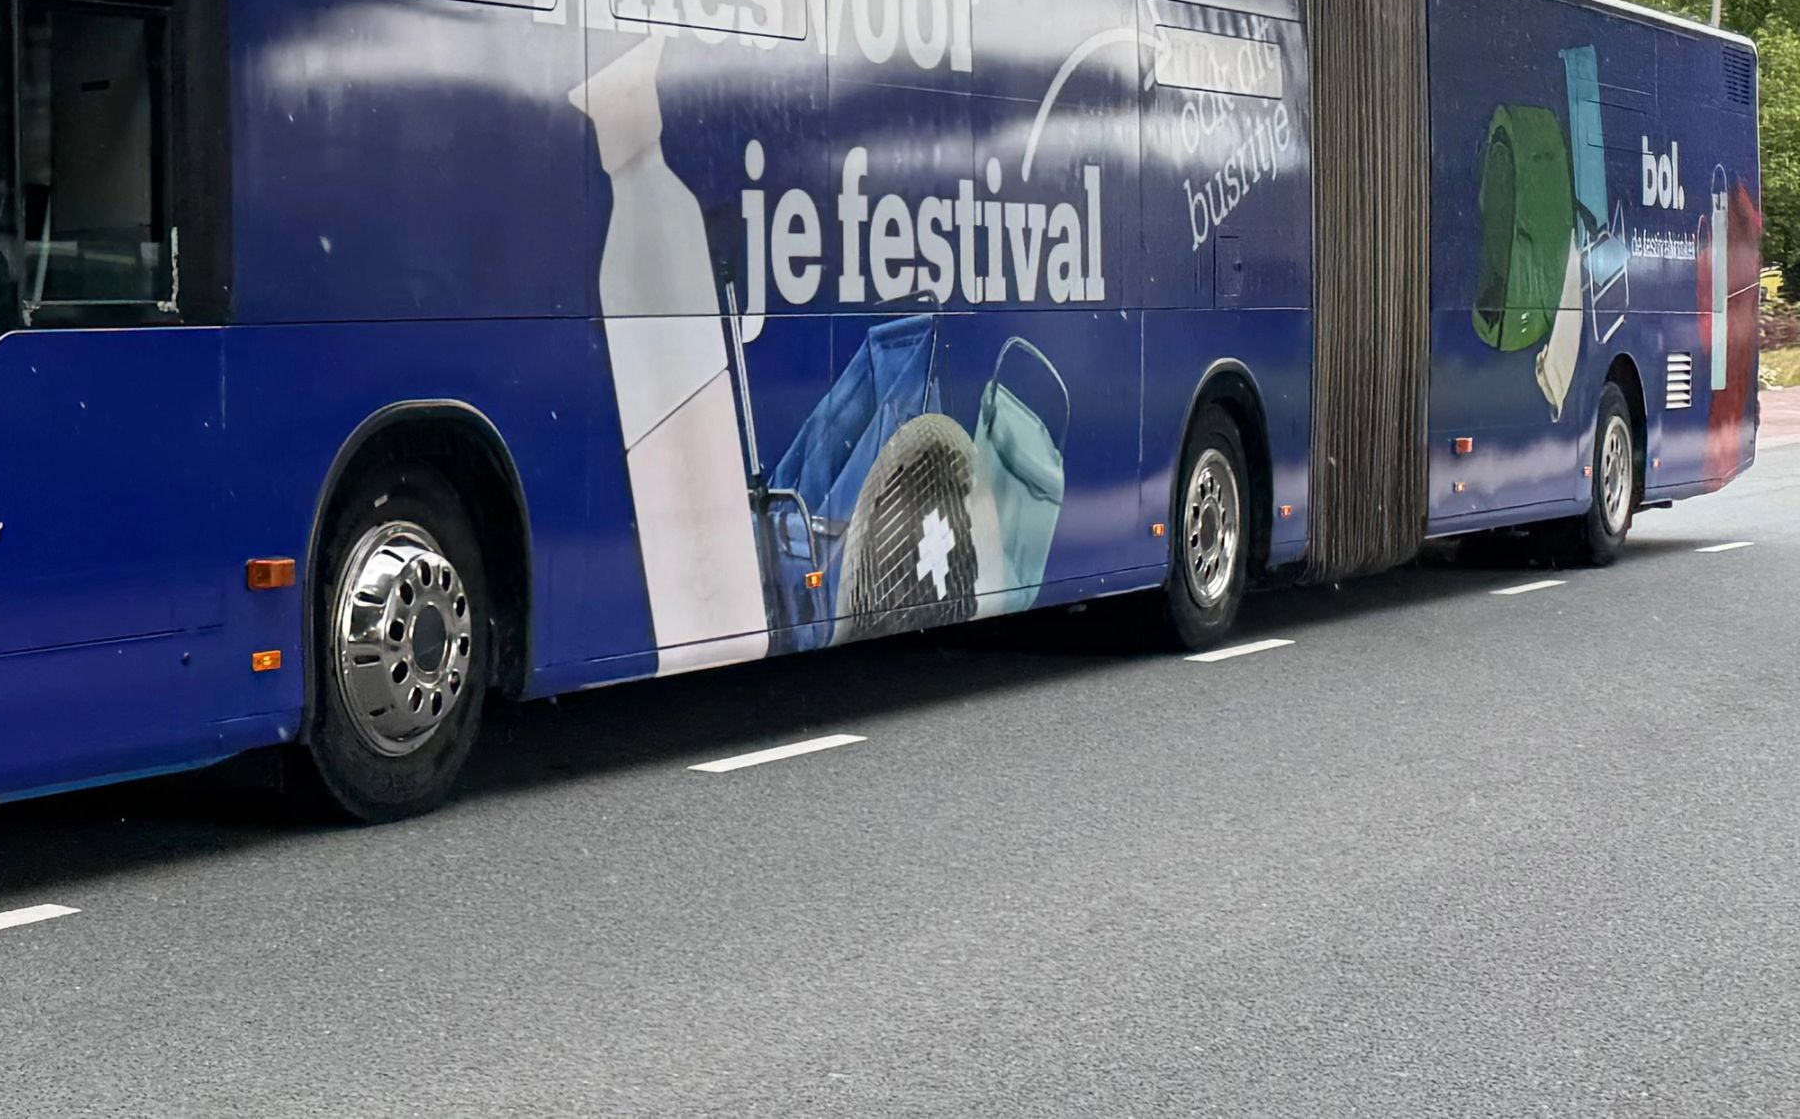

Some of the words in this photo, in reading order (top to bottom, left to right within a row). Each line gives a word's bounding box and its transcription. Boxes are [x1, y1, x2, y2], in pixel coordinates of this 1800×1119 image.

[741, 139, 823, 344] je
[837, 146, 1105, 306] festival
[1183, 100, 1290, 252] busritje
[1641, 135, 1685, 211] bol.
